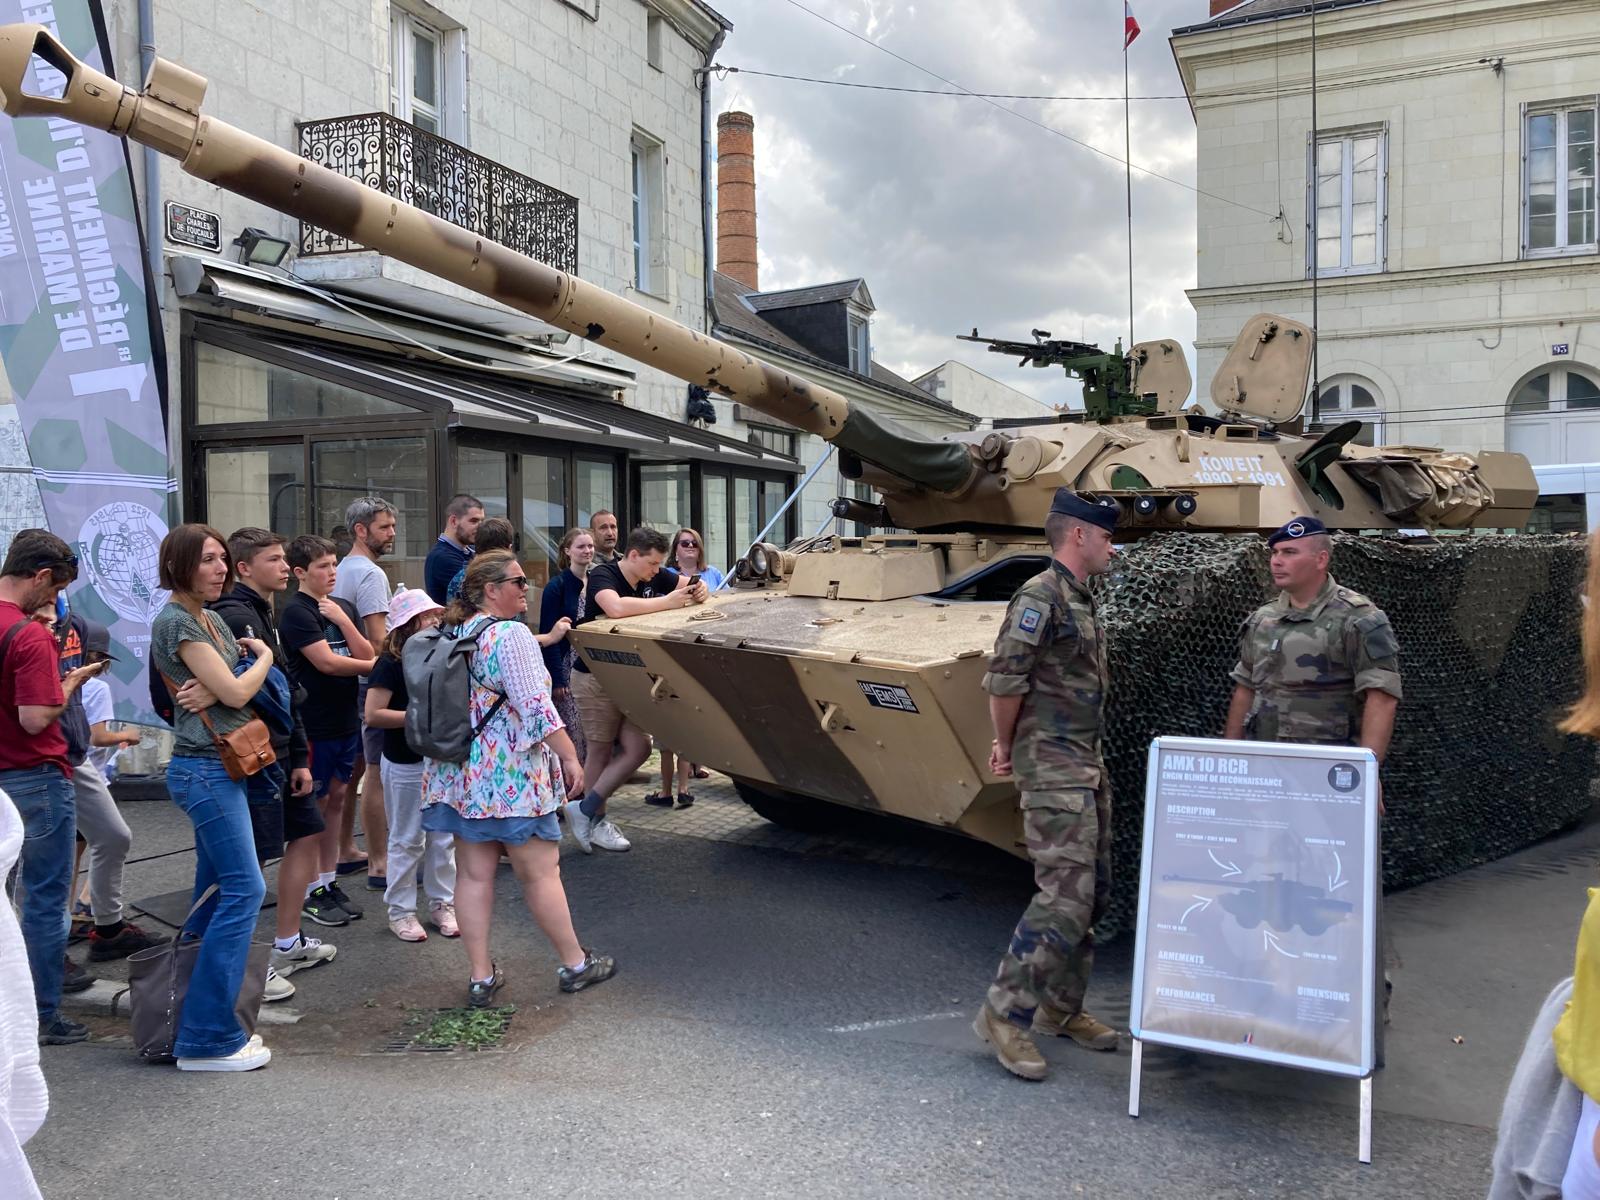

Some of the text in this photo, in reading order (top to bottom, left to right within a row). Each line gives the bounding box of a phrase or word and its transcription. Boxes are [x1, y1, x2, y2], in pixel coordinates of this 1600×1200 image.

[190, 209, 206, 221] PLACE
[176, 222, 184, 232] DE
[186, 226, 214, 240] FOUCAULD
[186, 217, 210, 230] CHARLES
[1198, 456, 1263, 472] KOWEIT
[1193, 471, 1233, 484] 1990
[1248, 472, 1286, 487] 1991
[875, 689, 898, 704] EMS
[1163, 754, 1249, 775] AMX 10 RCR
[1162, 771, 1184, 781] ENGIN
[1208, 775, 1218, 784] DE
[1218, 775, 1283, 788] RECONNAISSANCE
[1167, 804, 1216, 818] DESCRIPTION
[1158, 950, 1205, 965] ARMEMENTS
[1156, 986, 1216, 1004] PERFORMANCES
[1297, 986, 1350, 1003] DIMENSIONS
